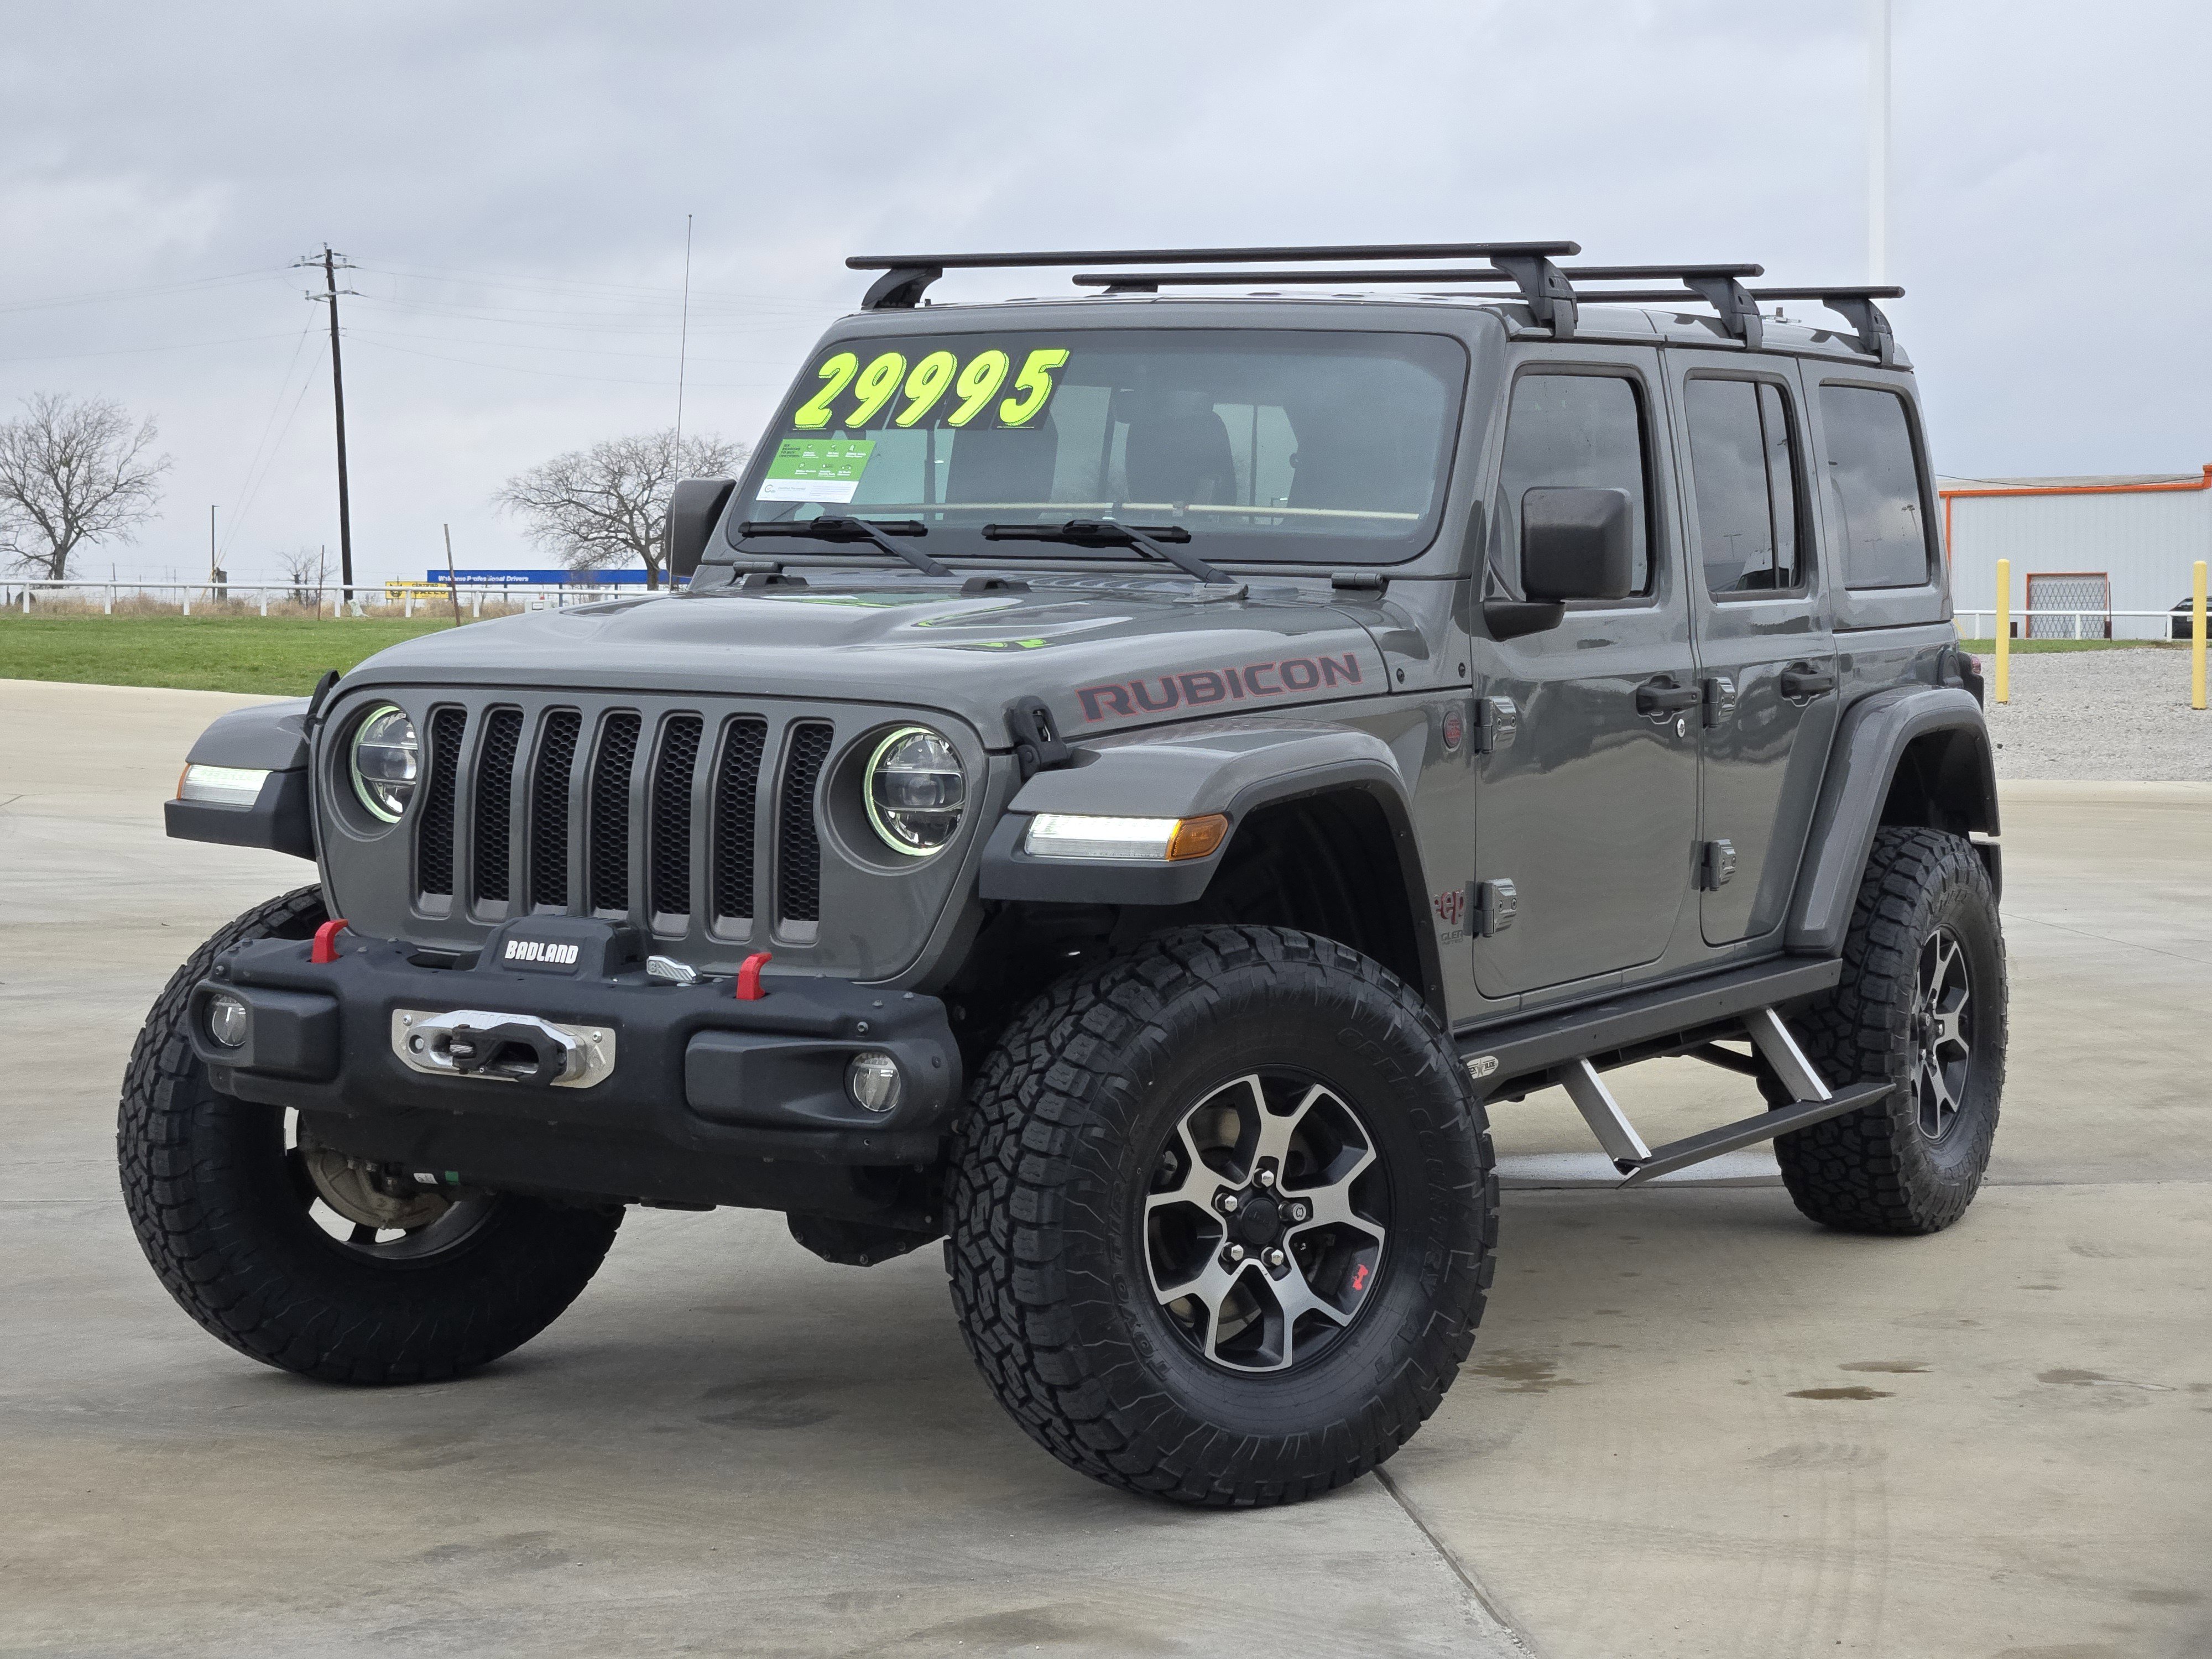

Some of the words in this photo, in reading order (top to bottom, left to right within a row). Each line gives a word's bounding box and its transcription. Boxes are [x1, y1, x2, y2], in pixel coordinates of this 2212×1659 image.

[794, 349, 1070, 428] 29995
[1075, 653, 1362, 723] RUBICON
[504, 940, 579, 964] BADLAND
[1110, 1272, 1171, 1383] TOYO
